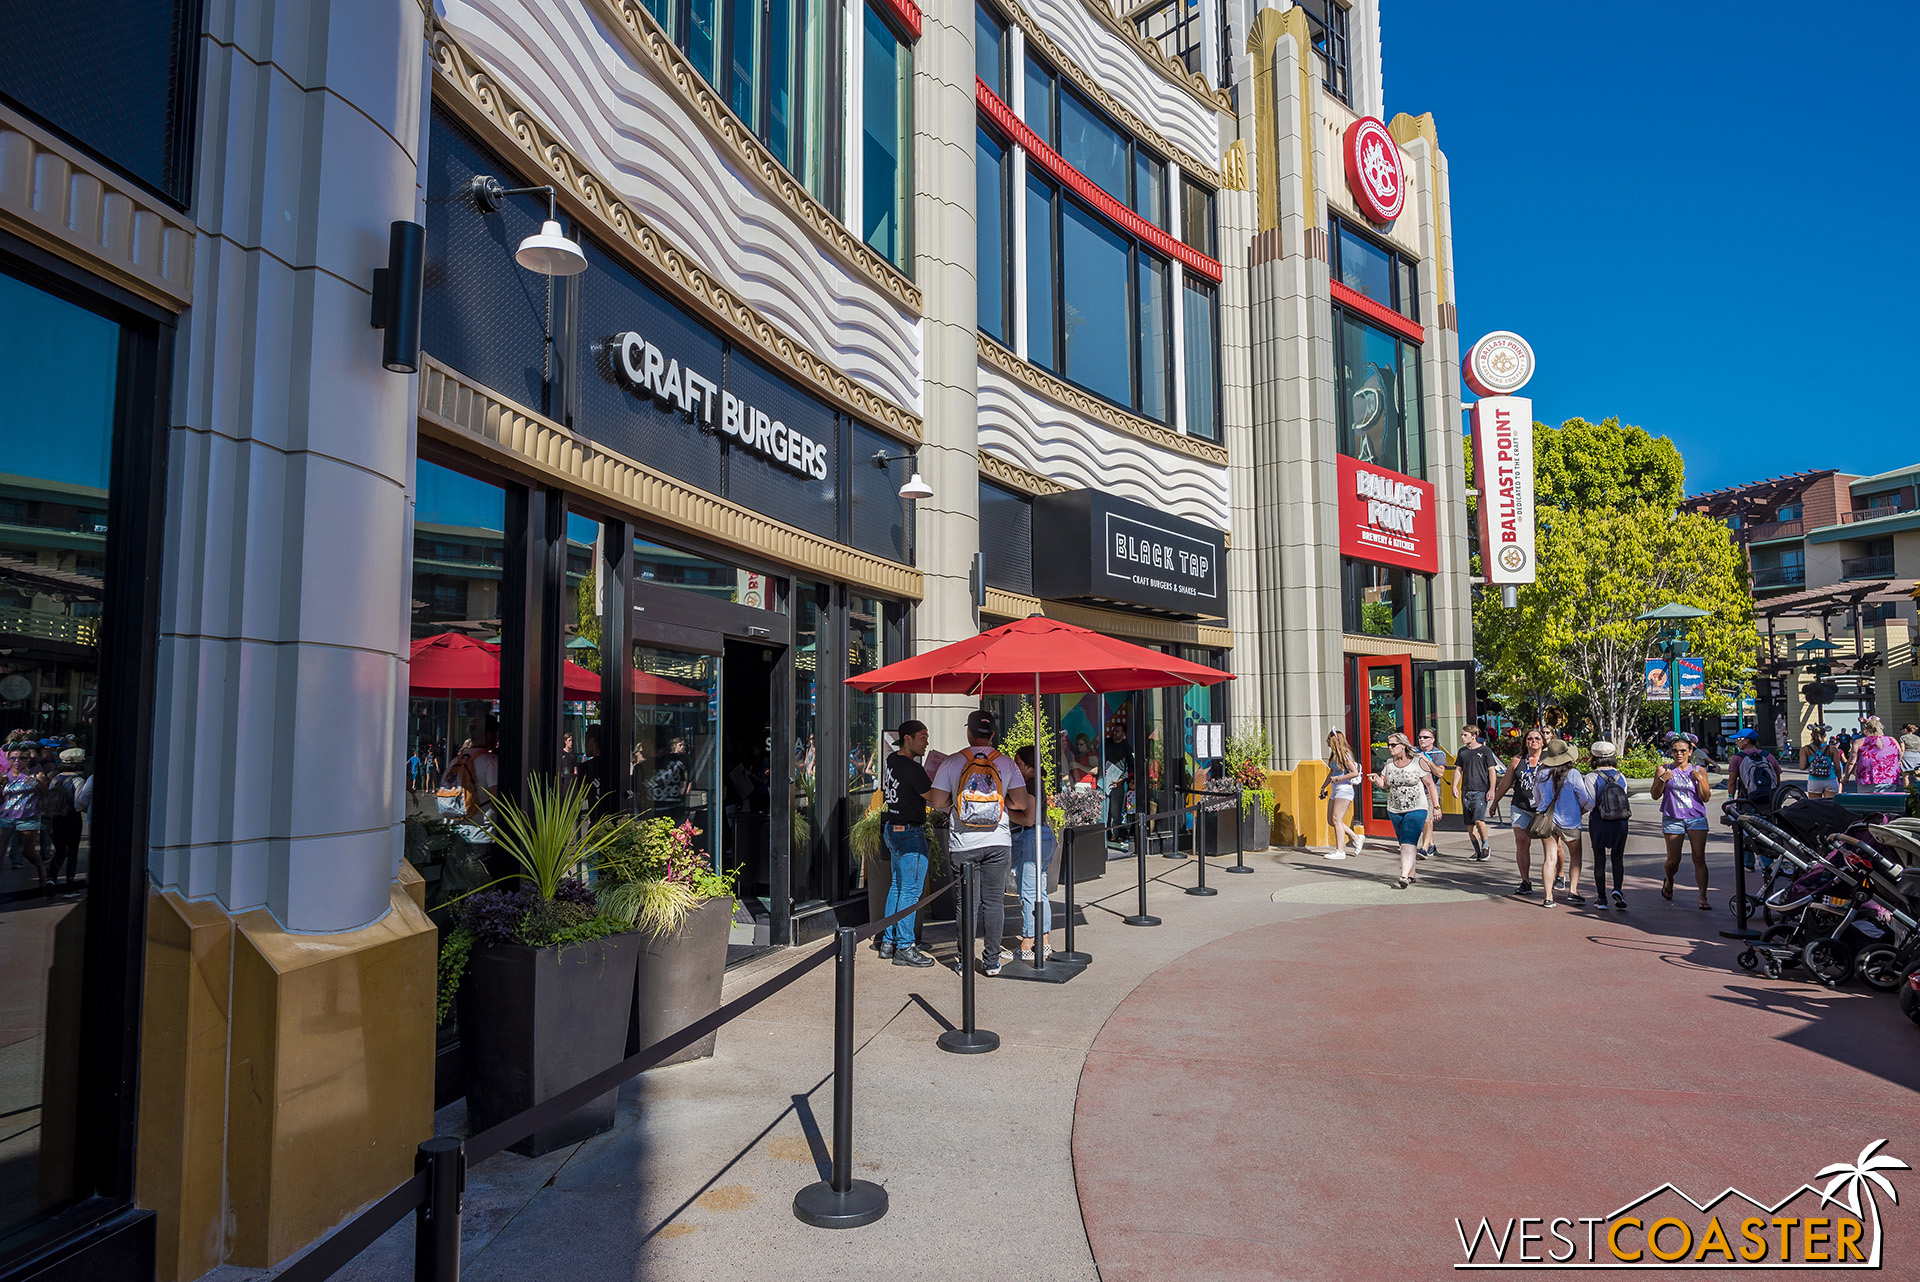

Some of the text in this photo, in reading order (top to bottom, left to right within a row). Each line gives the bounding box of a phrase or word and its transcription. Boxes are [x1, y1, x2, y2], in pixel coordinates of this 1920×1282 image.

[1480, 340, 1525, 360] BALLAST POINT
[622, 331, 828, 481] CRAFT BURGERS
[1356, 469, 1424, 511] BALLAST
[1495, 408, 1517, 543] BALLAST POINT
[1514, 471, 1521, 480] TO
[1515, 481, 1523, 515] DEDICATED
[1367, 499, 1417, 534] POINT
[1115, 532, 1209, 578] BLACK TAP
[1361, 530, 1415, 552] BREWERY & KITCHEN
[1132, 574, 1197, 596] CRAFT BURGERS & SHAKES
